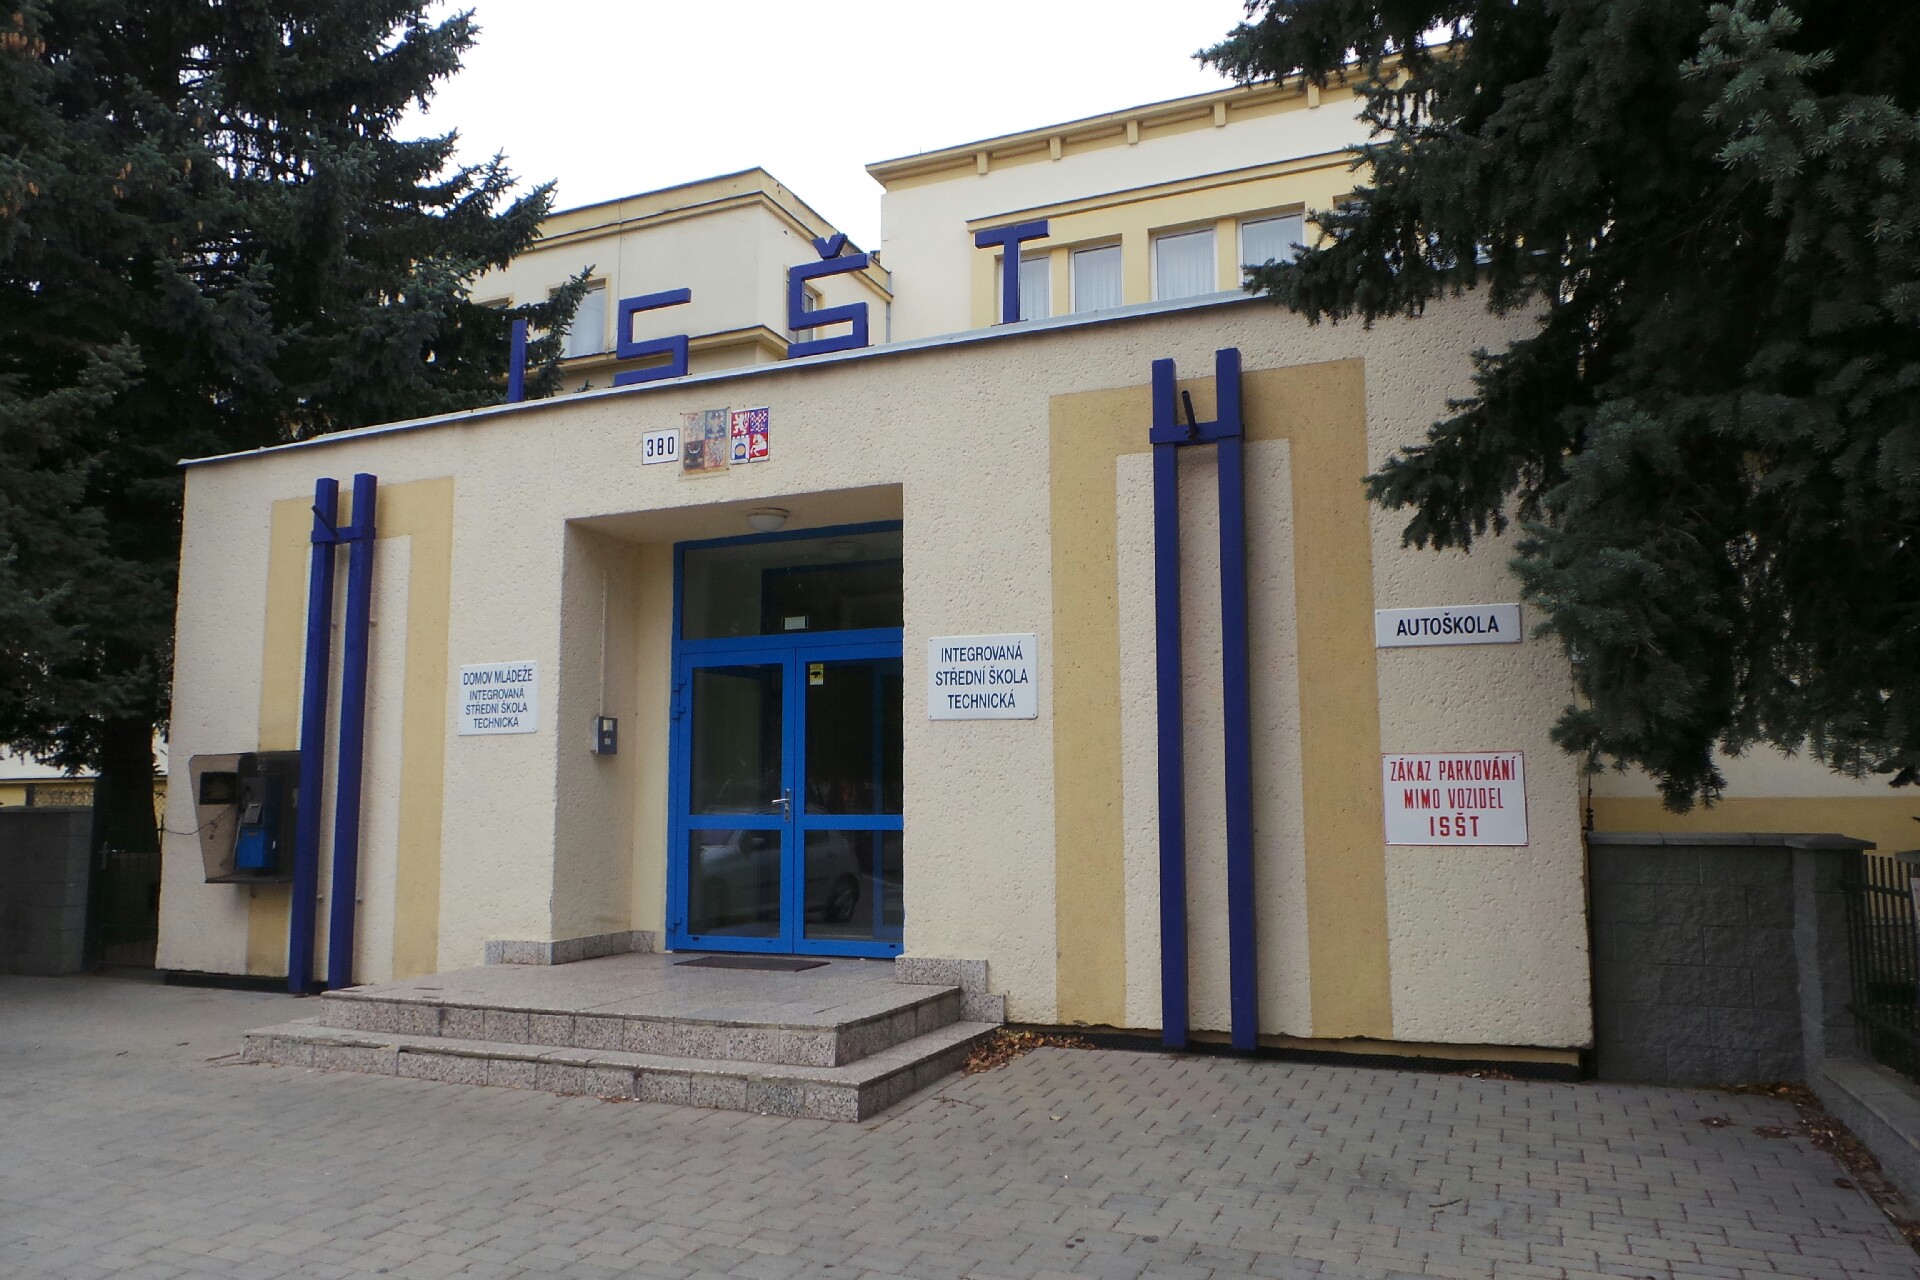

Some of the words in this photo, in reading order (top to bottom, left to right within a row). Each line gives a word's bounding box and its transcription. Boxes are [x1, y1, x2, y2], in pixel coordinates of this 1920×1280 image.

[646, 436, 675, 457] 380
[1396, 612, 1500, 637] AUTOŠKOLA
[941, 640, 1024, 663] INTEGROVANÁ
[463, 671, 493, 686] DOMOV
[494, 664, 533, 684] MLÁDEŽE
[935, 665, 986, 687] STŘEDNÍ
[988, 665, 1029, 685] ŠKOLA
[469, 685, 525, 701] INTEGROVANÁ
[947, 688, 1017, 709] TECHNICKÁ
[465, 700, 500, 716] STŘEDNÍ
[501, 700, 528, 714] ŠKOLA
[473, 714, 519, 729] TECHNICKÁ
[1390, 757, 1432, 782] ZÁKAZ
[1439, 756, 1517, 781] PARKOVÁNÍ
[1404, 788, 1441, 810] MIMO
[1448, 787, 1504, 809] VOZIDEL
[1430, 812, 1480, 837] ISŠT
